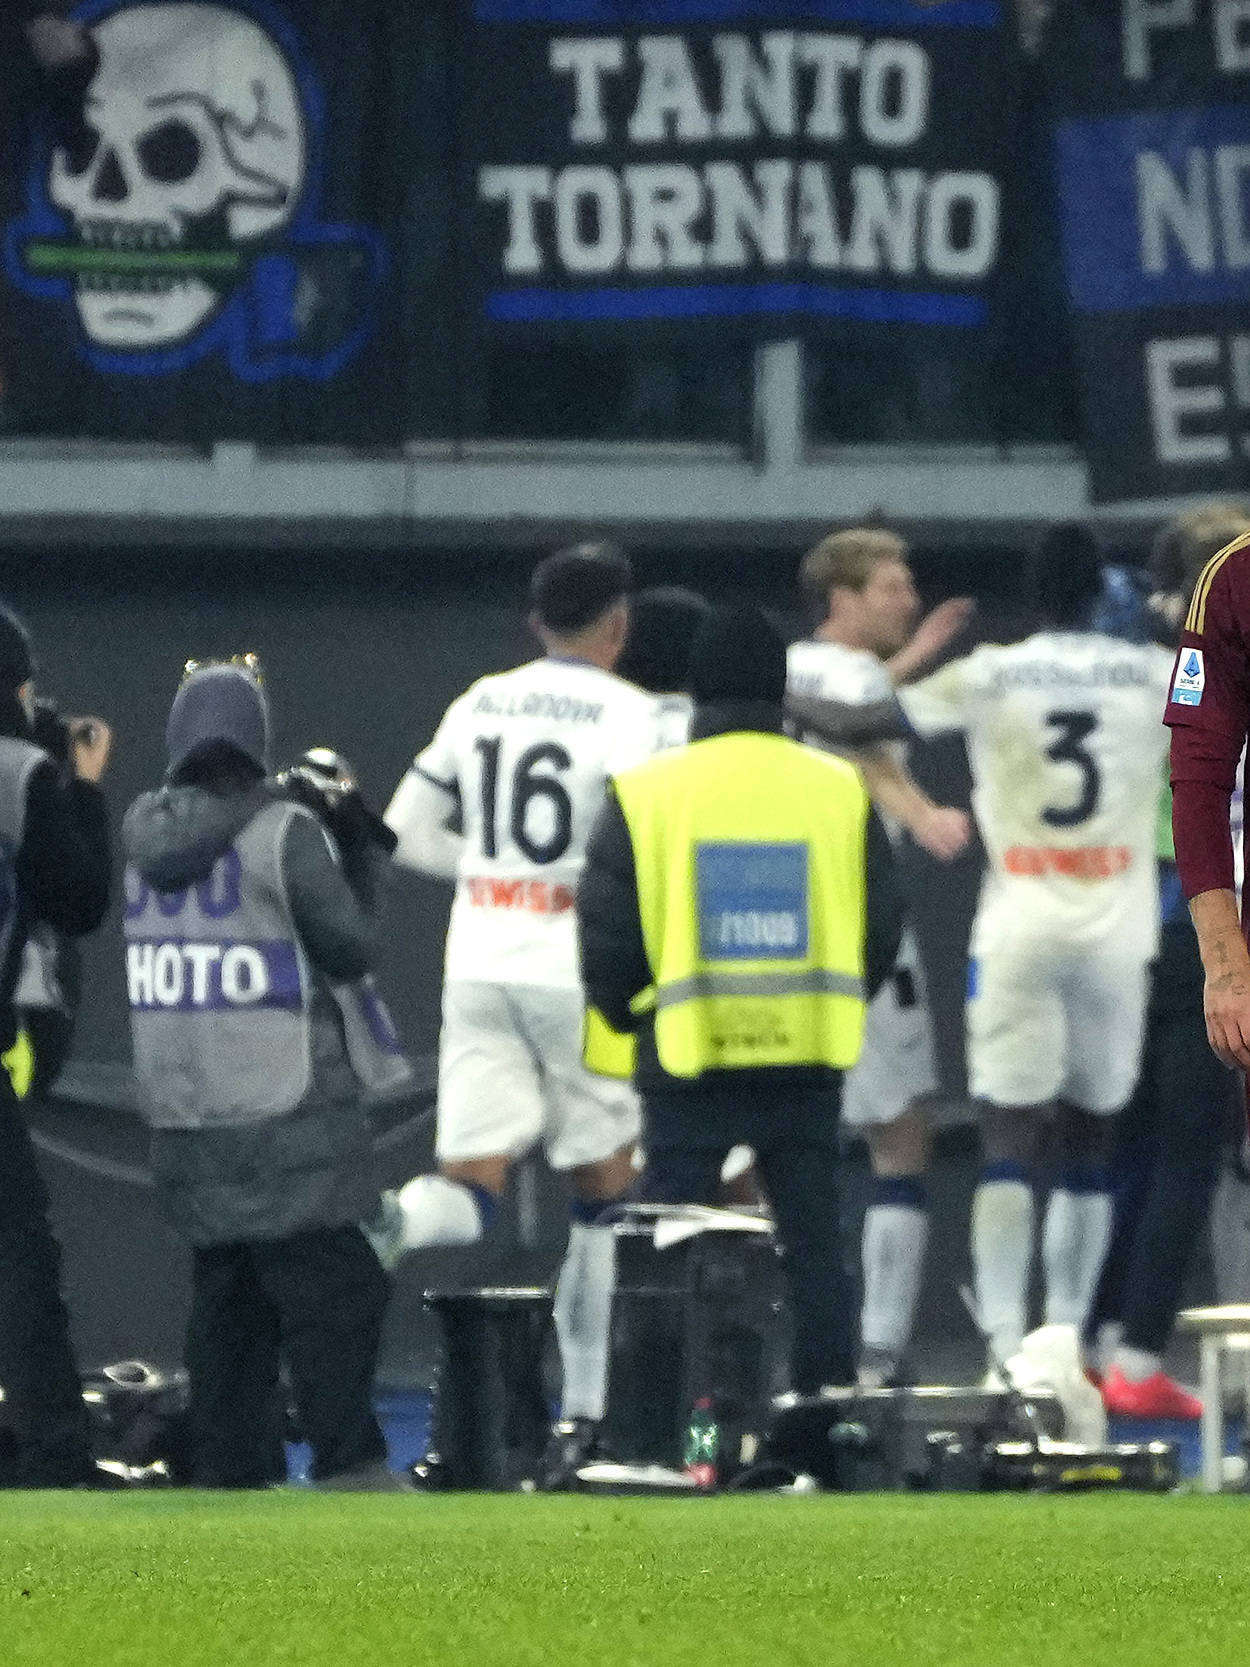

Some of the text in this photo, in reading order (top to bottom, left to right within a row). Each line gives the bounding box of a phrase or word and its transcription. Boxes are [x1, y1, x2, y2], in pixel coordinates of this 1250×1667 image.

[549, 31, 930, 147] TANTO
[478, 158, 1000, 278] TORNANO
[474, 733, 573, 866] 16
[1040, 707, 1103, 829] 3
